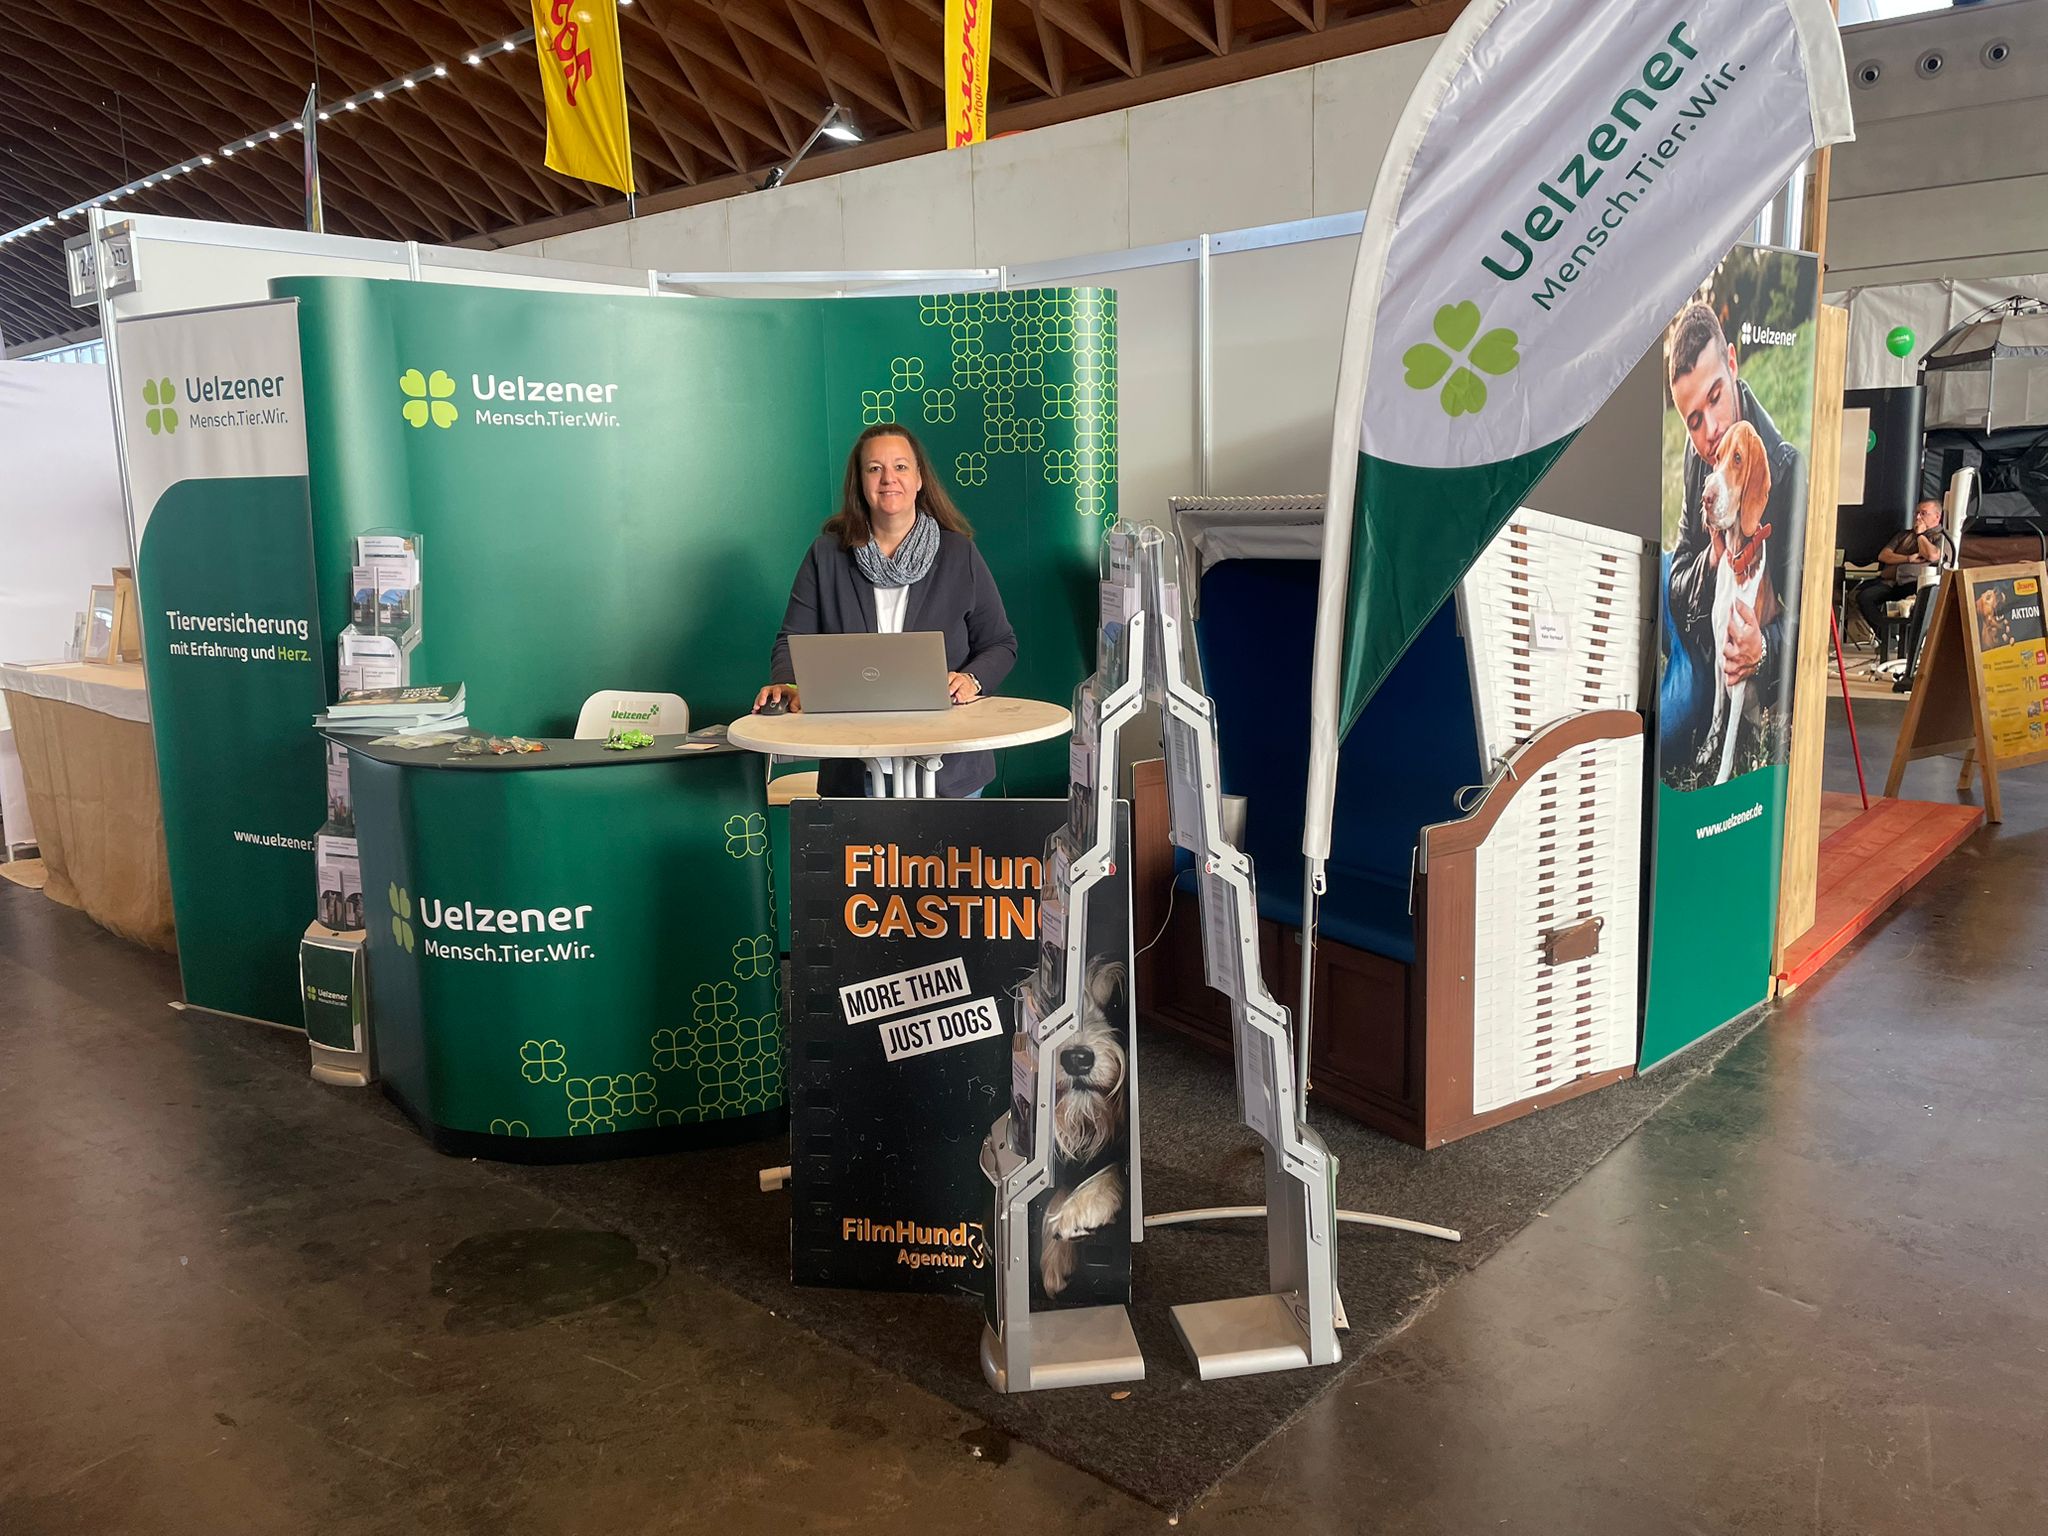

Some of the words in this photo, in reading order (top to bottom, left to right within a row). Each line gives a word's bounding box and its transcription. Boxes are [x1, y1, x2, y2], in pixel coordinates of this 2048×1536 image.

[1481, 20, 1699, 281] Uelzener
[1531, 62, 1746, 311] Mensch.Tier.Wir.
[1753, 325, 1797, 346] Uelzener
[185, 375, 285, 403] Uelzener
[472, 373, 618, 403] Uelzener
[190, 408, 289, 428] Mensch.Tier.Wir.
[475, 409, 620, 427] Mensch.Tier.Wir.
[166, 610, 308, 641] Tierversicherung
[2011, 605, 2040, 620] AKTION
[169, 640, 189, 656] mit
[190, 641, 248, 662] Erfahrung
[251, 645, 276, 660] und
[278, 646, 311, 662] Herz.
[611, 710, 652, 720] Uelzener
[1696, 802, 1763, 839] www.uelzener.de
[845, 843, 1044, 889] FilmHun
[420, 897, 592, 933] Uelzener
[844, 893, 1043, 940] CASTIN
[424, 939, 595, 963] Mensch.Tier.Wir.
[318, 988, 348, 1001] Uelzener
[845, 980, 905, 1018] MORE
[905, 965, 963, 1001] THAN
[888, 1019, 933, 1054] JUST
[937, 1005, 992, 1041] DOGS
[842, 1217, 967, 1246] FilmHund
[897, 1249, 967, 1269] Agentur
